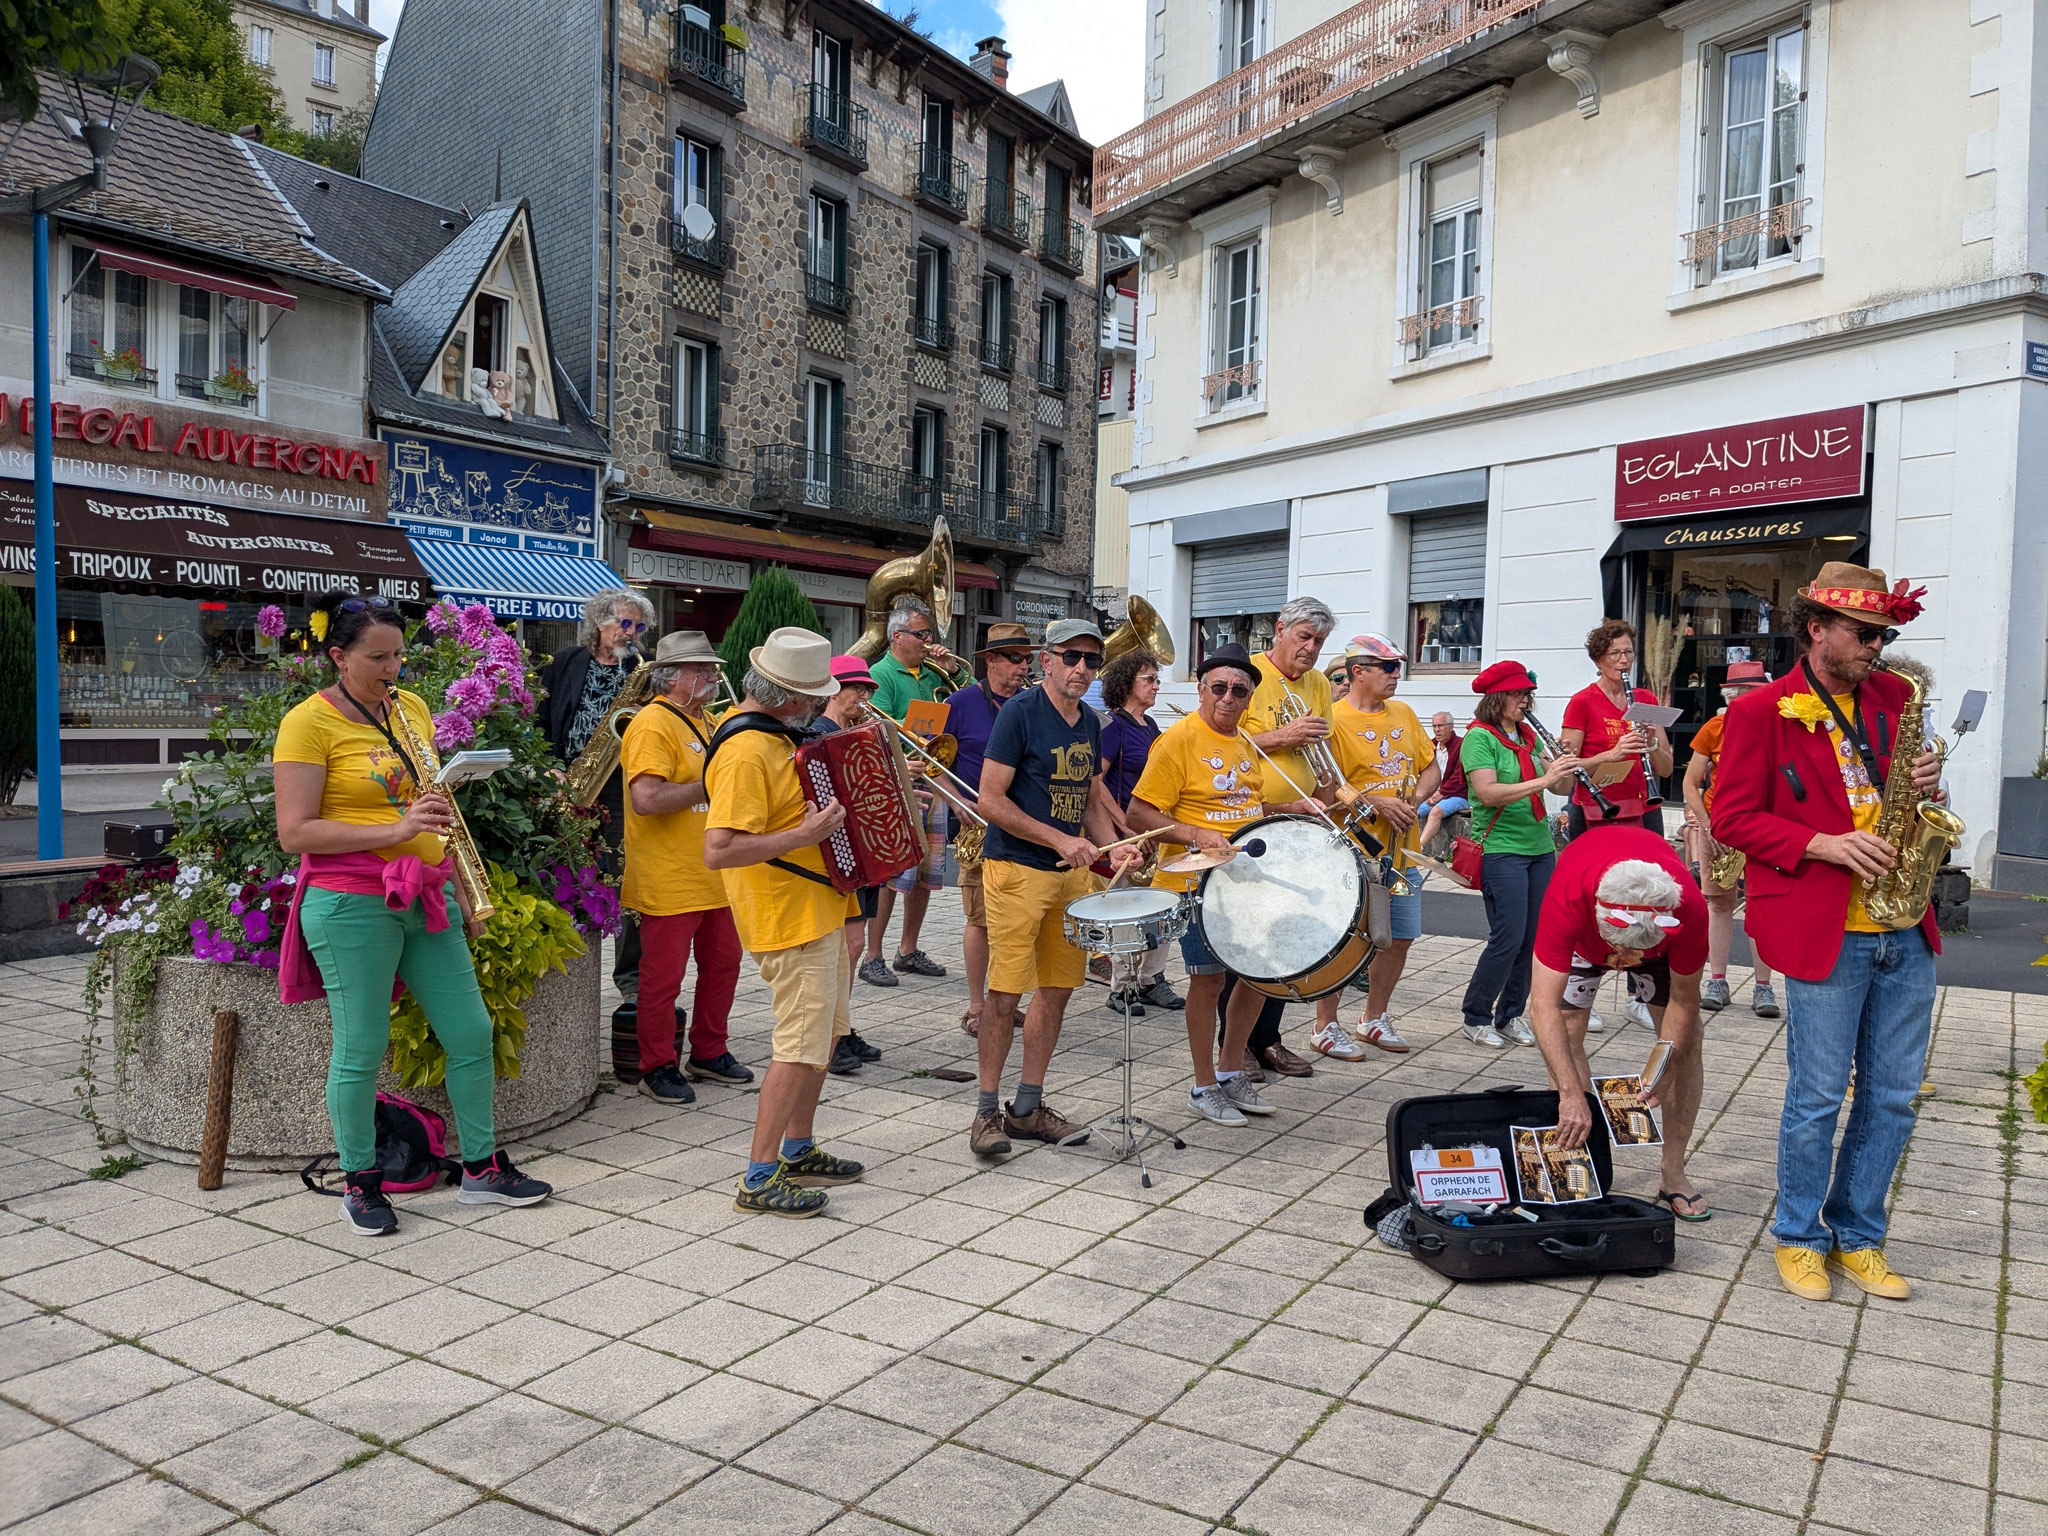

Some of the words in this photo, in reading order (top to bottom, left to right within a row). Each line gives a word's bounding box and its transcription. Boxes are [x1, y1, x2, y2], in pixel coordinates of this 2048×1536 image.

[172, 421, 387, 485] AUVERGNAT
[1623, 426, 1852, 485] EGLANTINE
[0, 490, 35, 504] Salais
[136, 467, 161, 486] ET
[168, 471, 274, 501] FROMAGES
[279, 487, 305, 504] AU
[311, 491, 371, 513] DETAIL
[1658, 490, 1701, 504] PRET
[1709, 487, 1721, 497] A
[1729, 477, 1803, 496] PORTER
[86, 498, 231, 527] SPECIALITÉS
[185, 530, 335, 556] AUVERGNATES
[409, 524, 426, 535] PETIT
[427, 526, 453, 538] BATEAU
[480, 532, 507, 545] Janod
[1663, 520, 1805, 545] Chaussures
[69, 551, 153, 581] TRIPOUX
[176, 560, 241, 587] POUNTI
[262, 568, 360, 595] CONFITURES
[378, 577, 420, 601] MIELS
[632, 552, 698, 581] POTERIE
[702, 561, 746, 586] D'ART
[485, 597, 533, 616] FREE
[537, 602, 586, 620] MOUS
[1015, 600, 1065, 616] CORDONNERIE
[1450, 1154, 1462, 1164] 34
[1430, 1176, 1476, 1186] ORPHEON
[1477, 1175, 1491, 1184] DE
[1434, 1187, 1492, 1197] GARRAFACH
